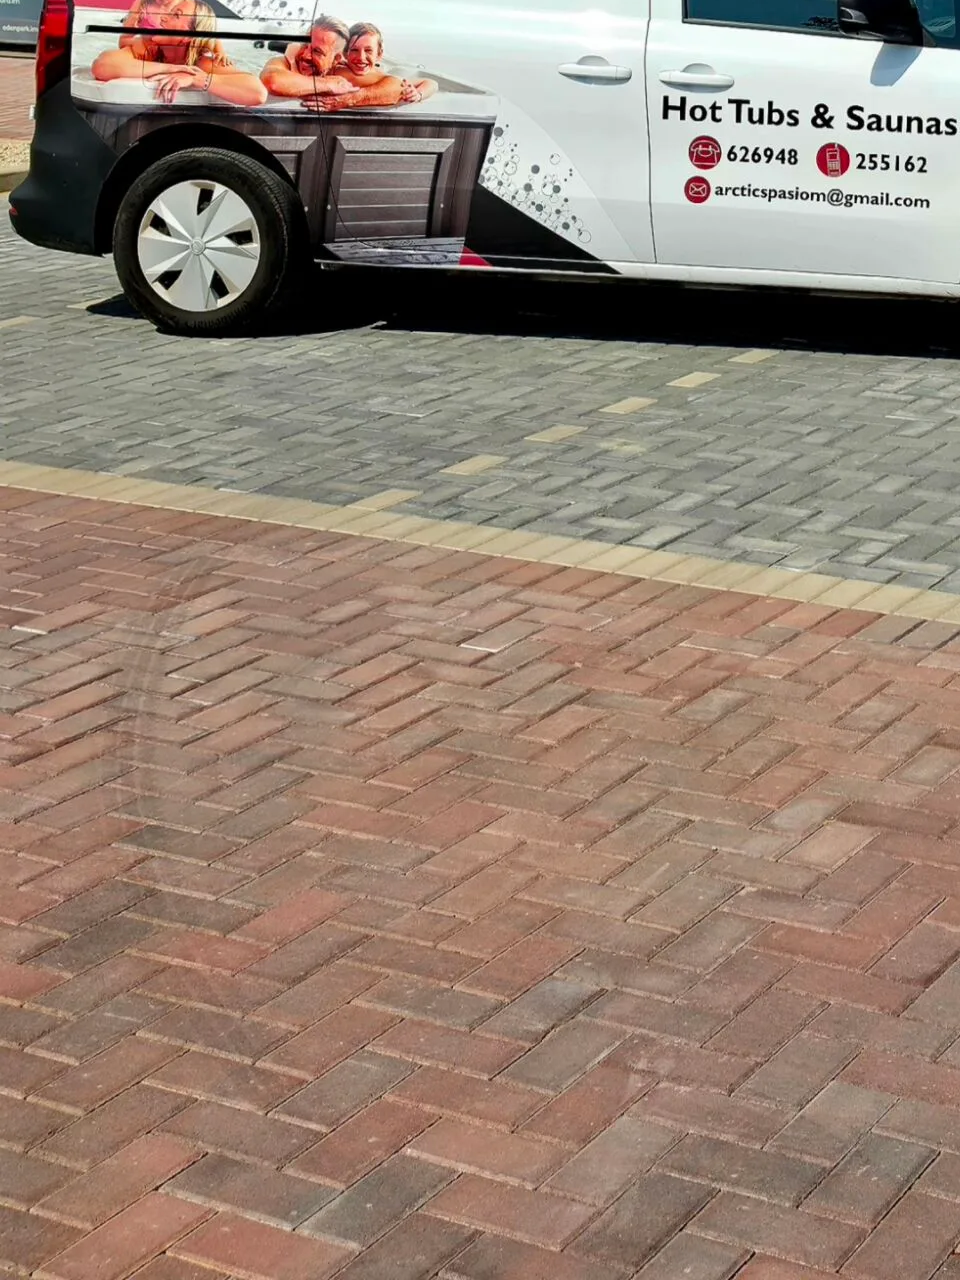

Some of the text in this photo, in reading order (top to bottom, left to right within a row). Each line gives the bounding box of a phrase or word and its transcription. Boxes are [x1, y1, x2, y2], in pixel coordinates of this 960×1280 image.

[661, 95, 958, 136] Hot Tubs & Saunas
[726, 145, 928, 173] 626948 255162
[714, 183, 931, 208] arcticspasiom@gmail.com
